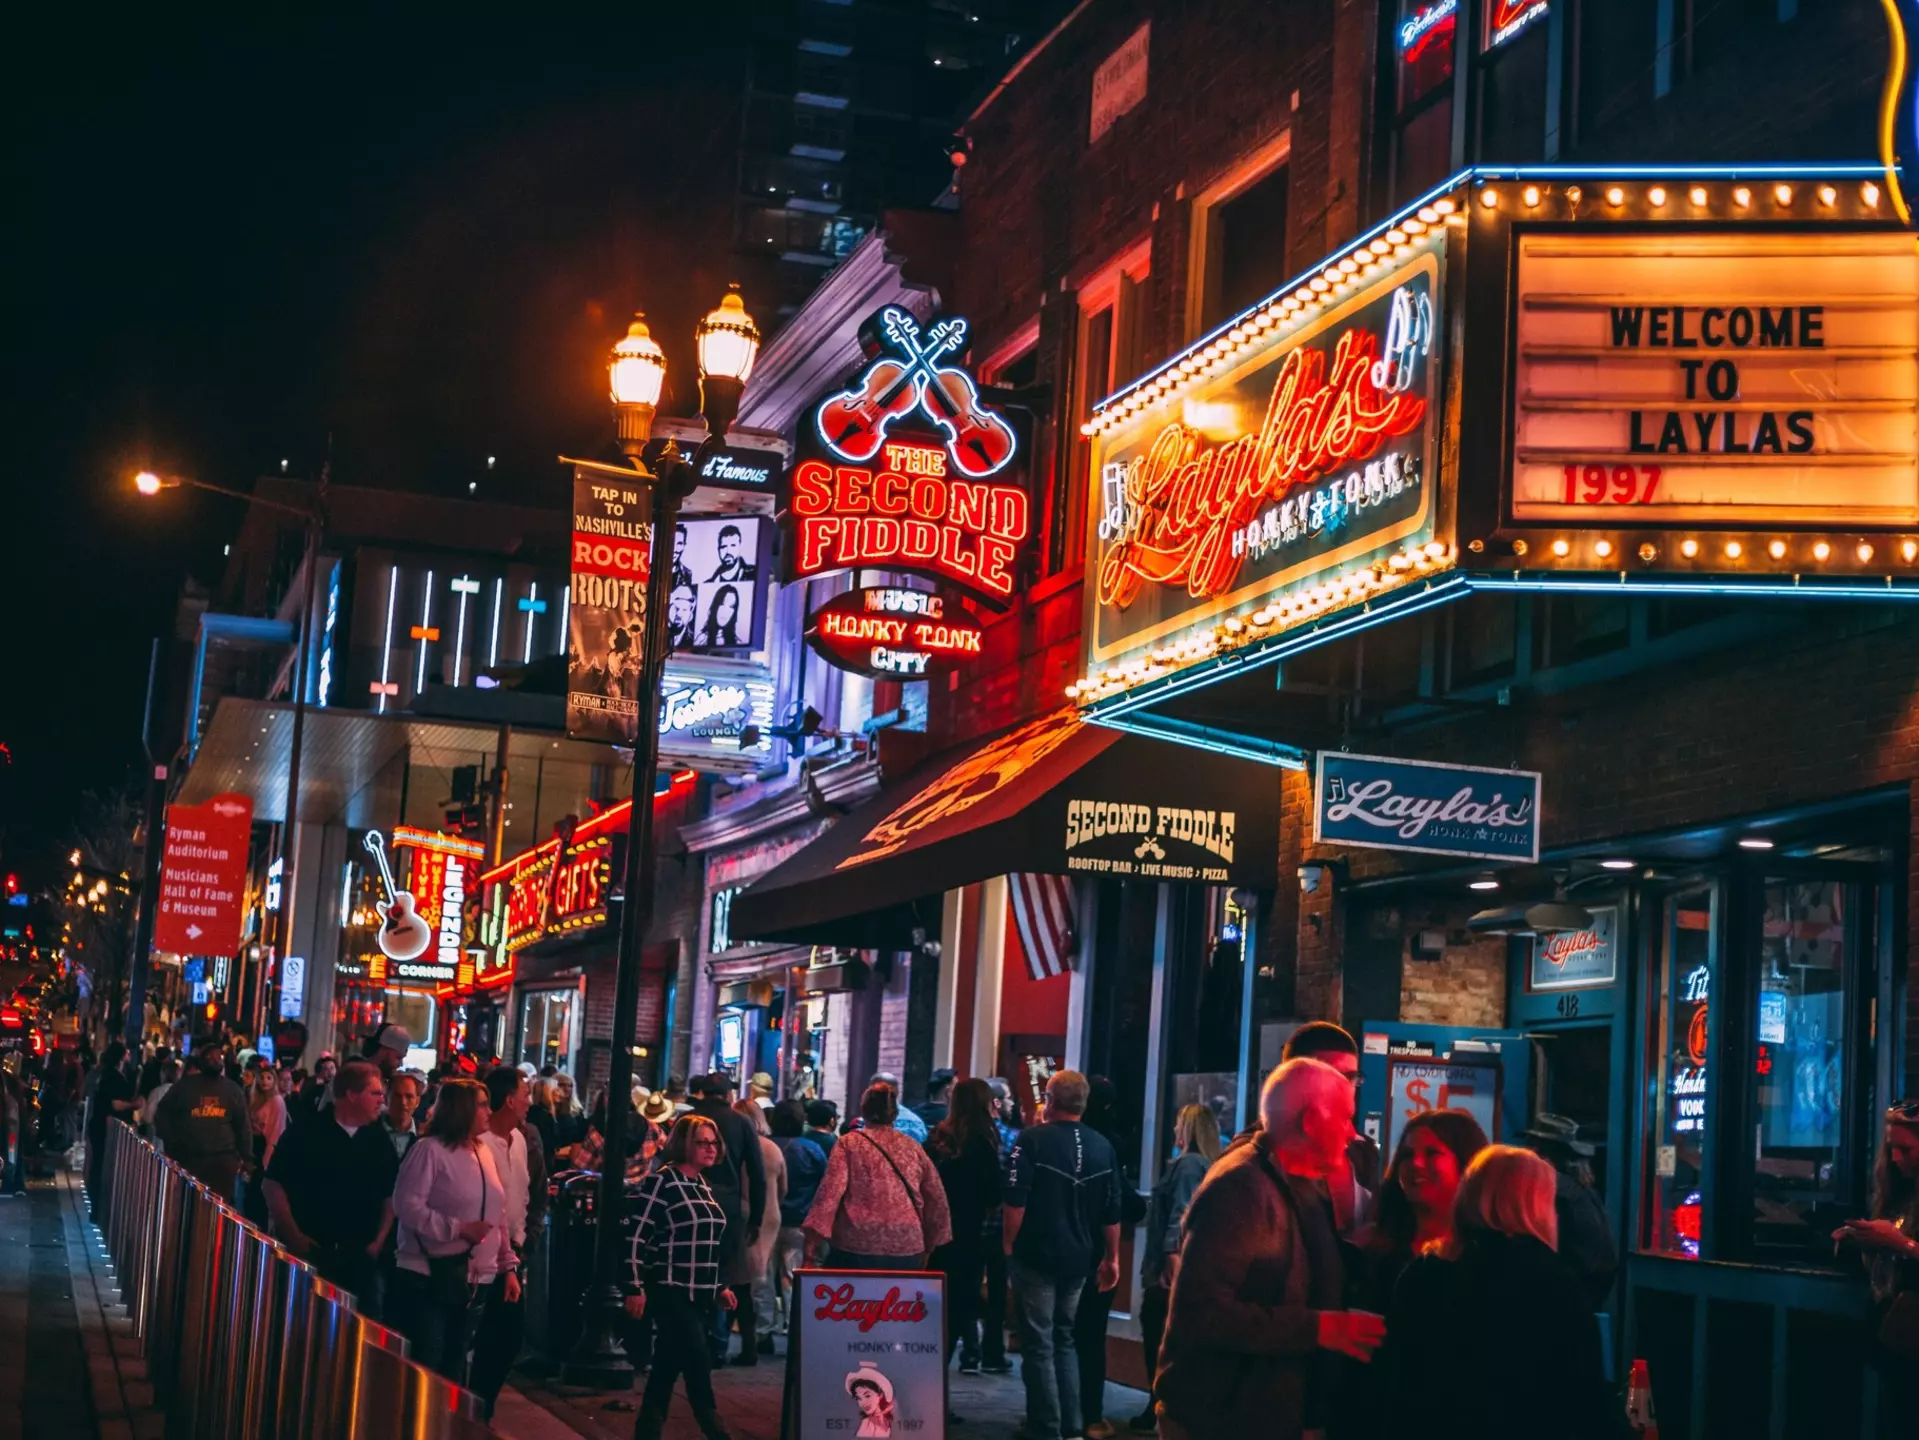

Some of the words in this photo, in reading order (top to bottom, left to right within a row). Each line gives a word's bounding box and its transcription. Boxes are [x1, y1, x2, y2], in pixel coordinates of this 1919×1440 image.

[1610, 306, 1825, 348] WELCOME
[1680, 359, 1740, 401] TO
[1629, 411, 1815, 453] LAYLAS
[715, 456, 769, 482] Famous
[886, 443, 947, 477] THE
[591, 485, 619, 501] TAP
[623, 491, 637, 505] IN
[1563, 464, 1662, 505] 1997
[604, 502, 624, 516] TO
[795, 461, 1028, 541] SECOND
[1231, 488, 1311, 559] HONKY
[1330, 452, 1402, 514] TONK
[575, 514, 652, 541] NASHVILLE'S
[573, 540, 649, 573] ROCK
[802, 516, 1016, 594] FIDDLE
[571, 573, 648, 614] ROOTS
[864, 590, 944, 619] MUSIC
[825, 613, 908, 642] HONKY
[915, 624, 982, 652] TONK
[870, 646, 932, 674] CITY
[573, 694, 600, 708] RYMAN
[1327, 778, 1528, 839] Layla's
[169, 826, 206, 842] Ryman
[1065, 799, 1151, 851] SECOND
[1156, 806, 1236, 865] FIDDLE
[167, 844, 229, 861] Auditorium
[165, 867, 219, 885] Musicians
[1068, 857, 1110, 872] ROOFTOP
[1112, 861, 1131, 874] BAR
[1141, 863, 1160, 876] LIVE
[1162, 866, 1193, 879] MUSIC
[1202, 868, 1229, 881] PIZZA
[163, 884, 187, 898] Hall
[190, 886, 201, 899] of
[204, 887, 233, 903] Fame
[555, 857, 599, 917] GIFTS
[173, 902, 218, 917] Museum
[438, 854, 465, 964] LEGENDS
[398, 964, 455, 980] CORNER
[1681, 1099, 1706, 1116] VODK
[814, 1282, 929, 1333] Layla's
[847, 1341, 893, 1354] HONKY
[905, 1342, 939, 1355] TONK
[826, 1418, 850, 1431] EST
[897, 1419, 924, 1431] 1997
